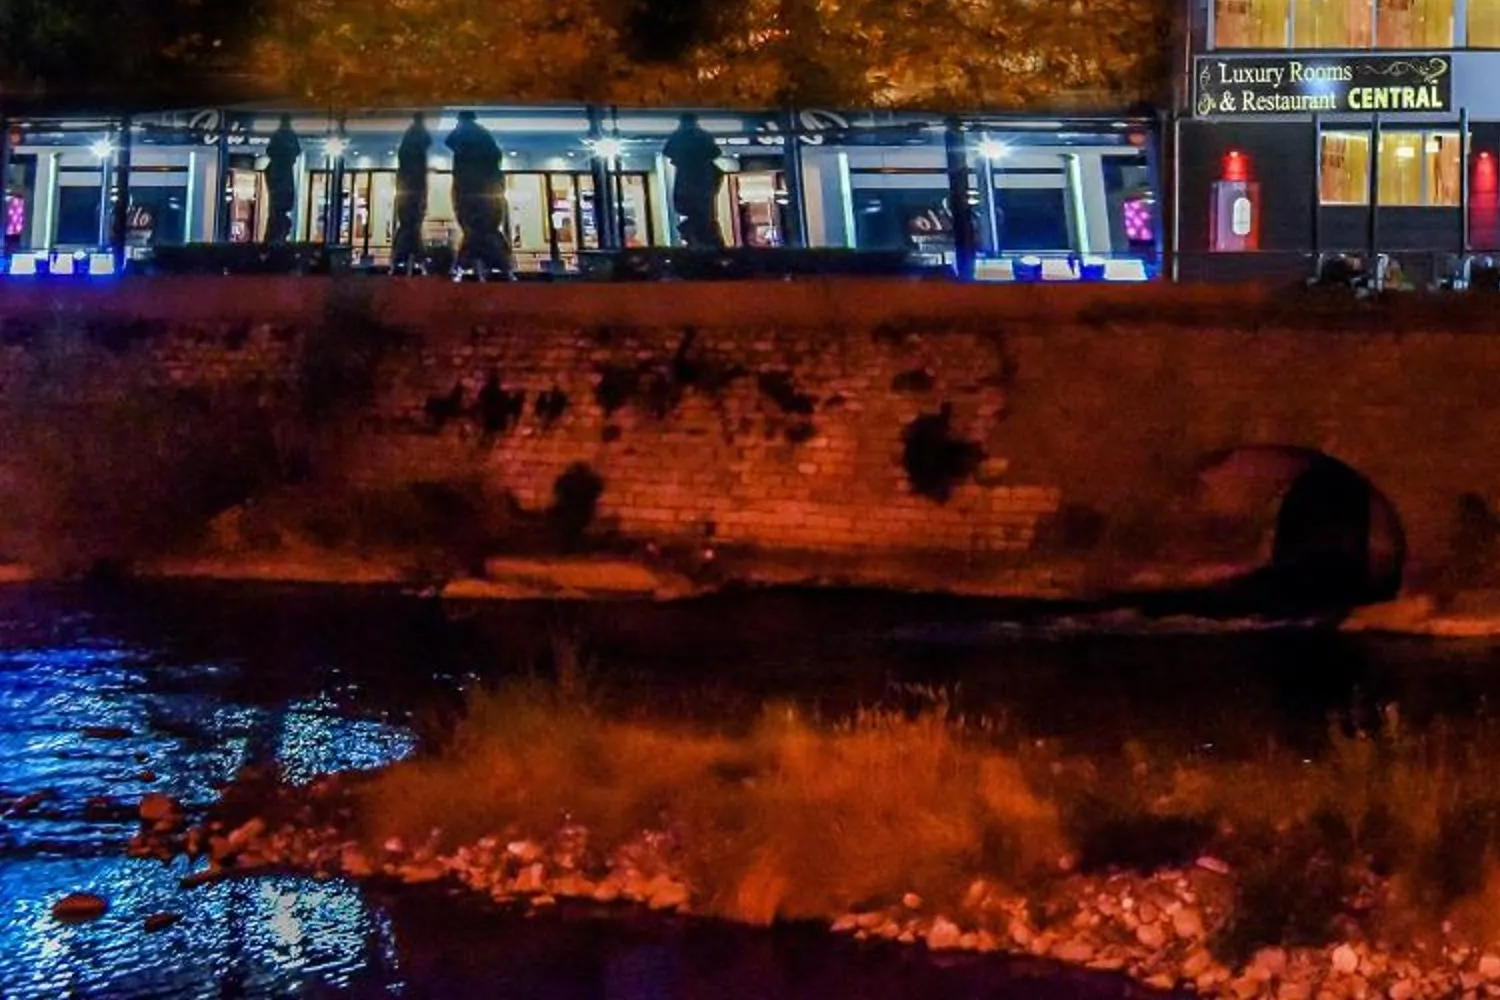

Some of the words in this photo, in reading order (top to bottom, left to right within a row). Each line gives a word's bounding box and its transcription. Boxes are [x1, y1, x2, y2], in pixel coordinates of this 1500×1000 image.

[1218, 62, 1284, 88] Luxury
[1290, 62, 1353, 83] Rooms
[1219, 91, 1237, 111] &
[1243, 91, 1337, 112] Restaurant
[1348, 86, 1442, 110] CENTRAL
